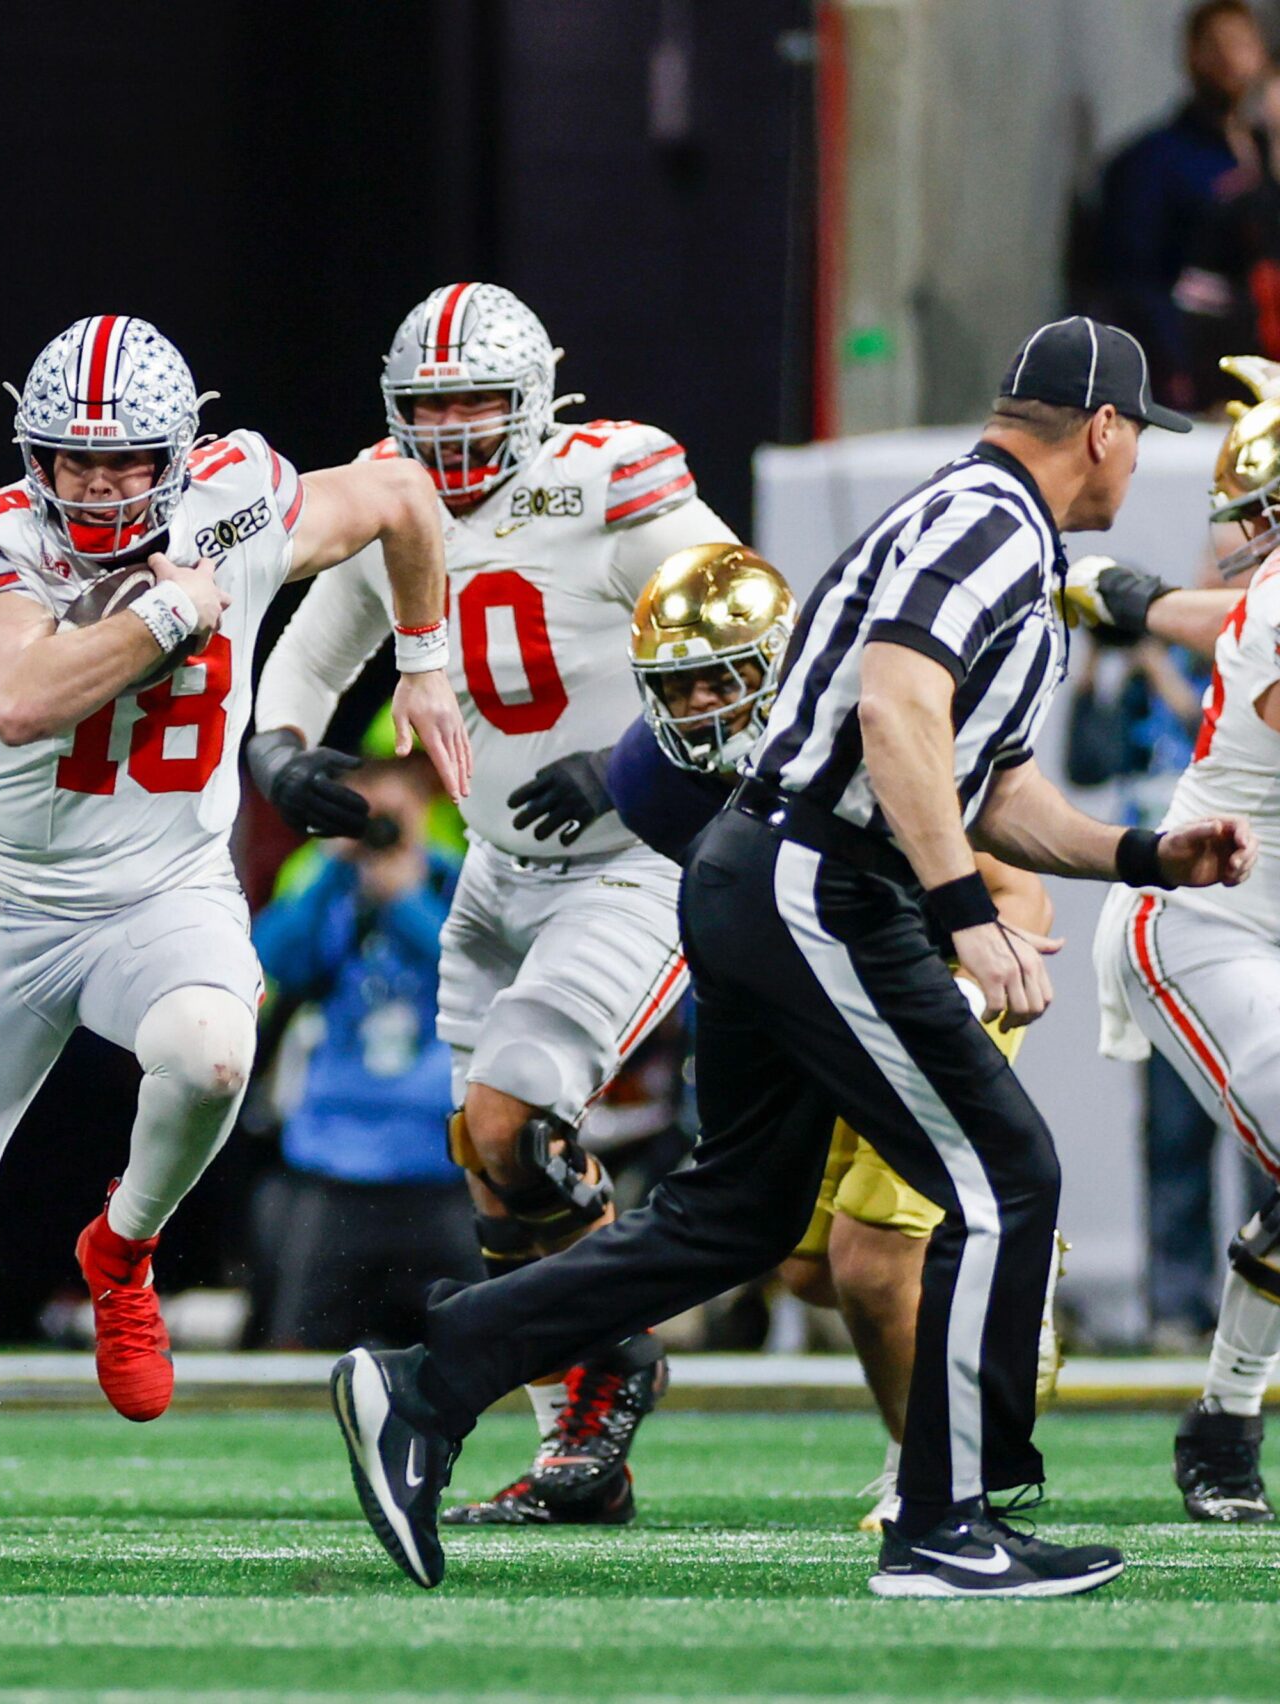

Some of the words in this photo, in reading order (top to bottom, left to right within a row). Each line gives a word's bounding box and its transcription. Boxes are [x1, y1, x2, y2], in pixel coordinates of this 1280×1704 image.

[70, 425, 91, 436] OHIO
[93, 425, 118, 437] STATE
[195, 496, 272, 559] 2025
[511, 486, 583, 517] 2025
[444, 569, 569, 736] 0
[56, 632, 232, 796] 18
